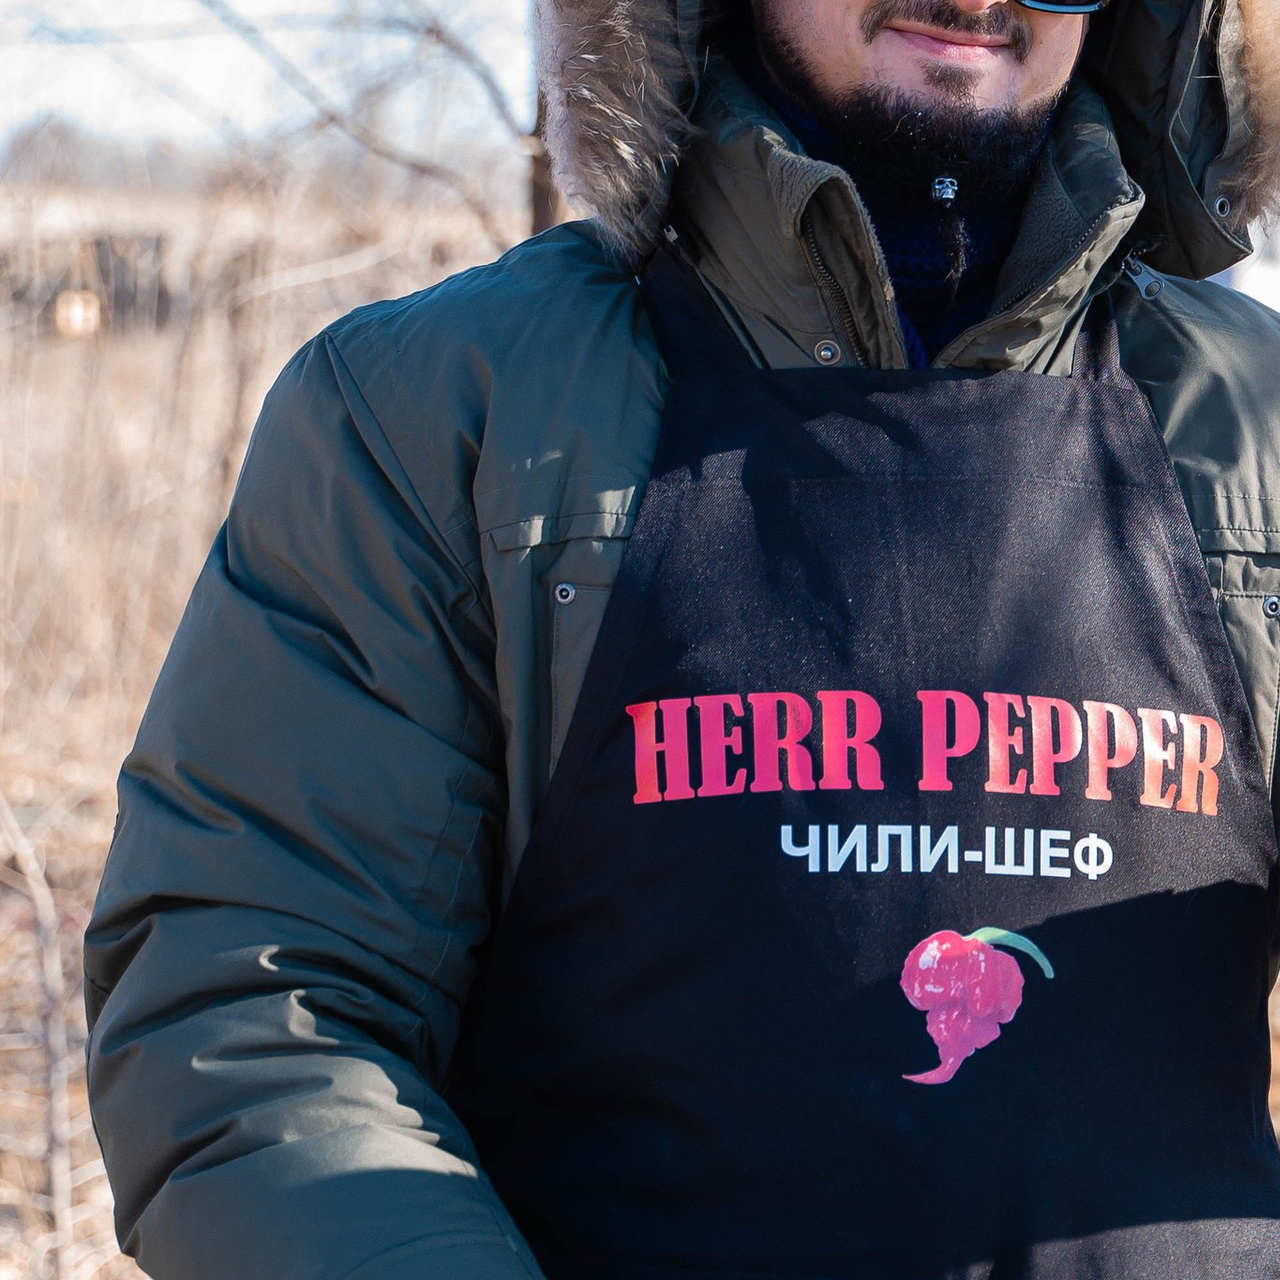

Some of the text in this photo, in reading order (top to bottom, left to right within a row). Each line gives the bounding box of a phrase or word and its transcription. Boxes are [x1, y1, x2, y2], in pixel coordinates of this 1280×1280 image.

[625, 689, 1225, 816] HERR PEPPER
[780, 823, 1114, 880] ЧИЛИ-ШЕФ
